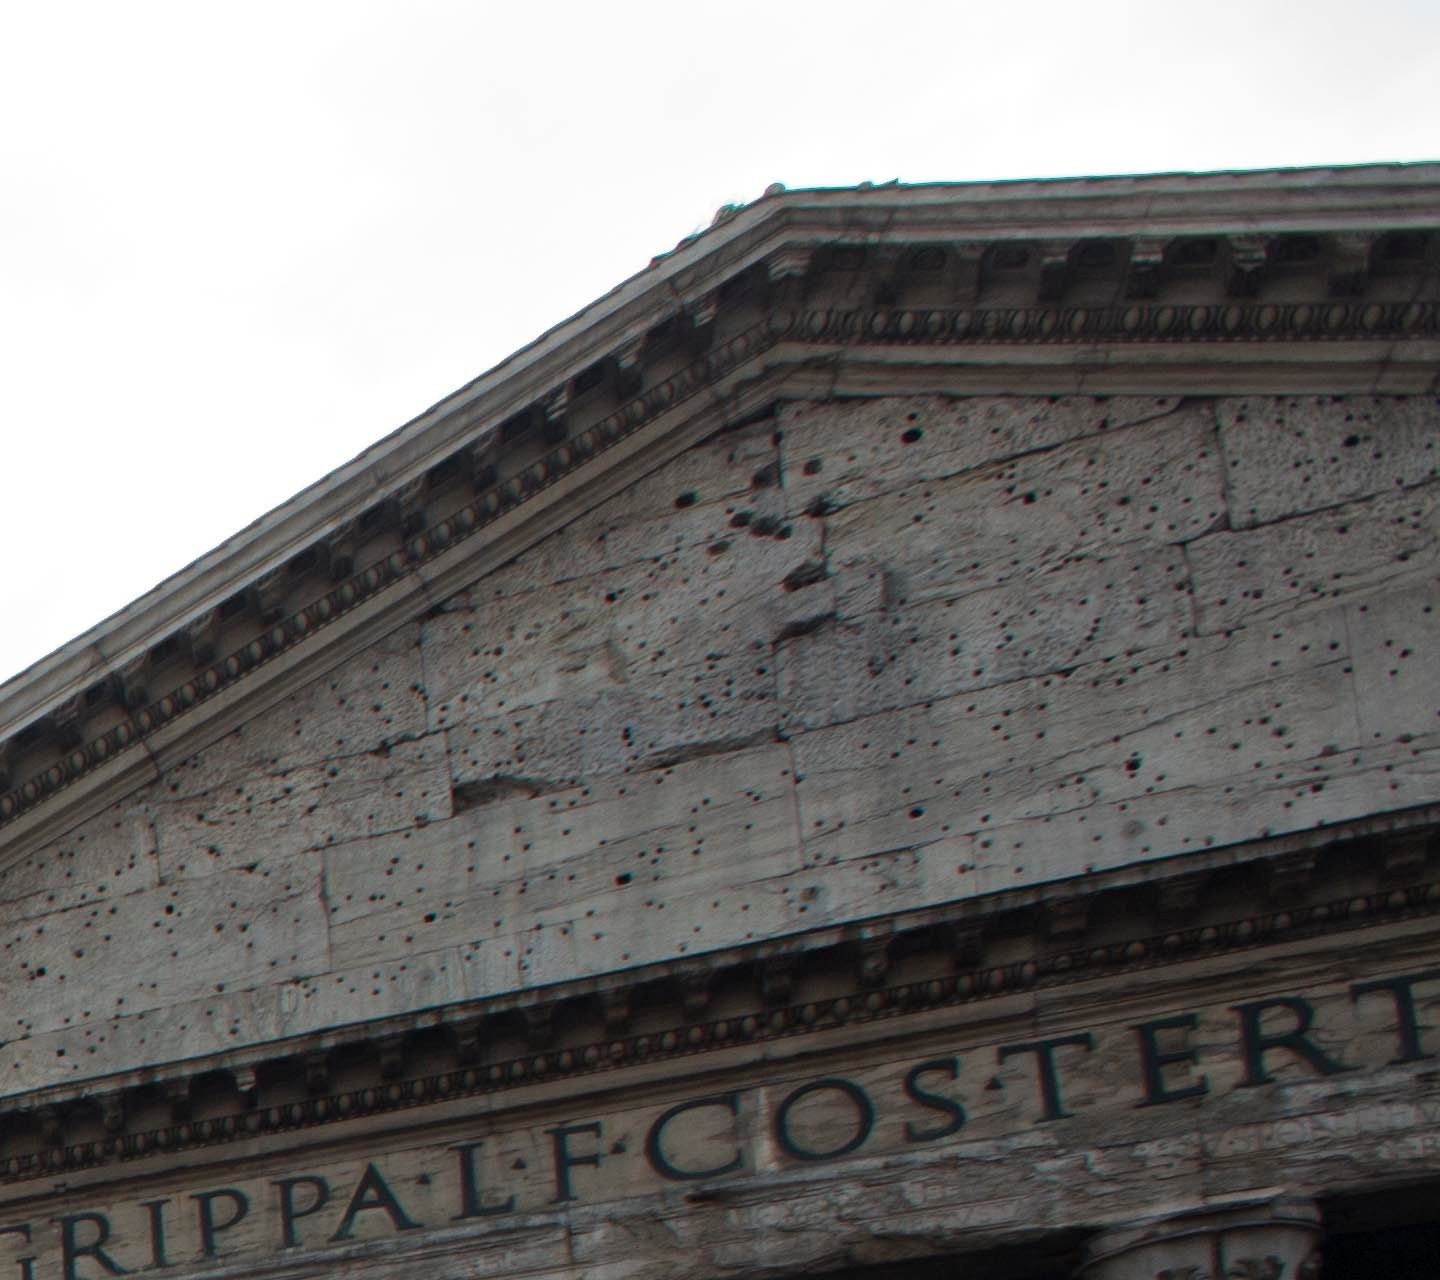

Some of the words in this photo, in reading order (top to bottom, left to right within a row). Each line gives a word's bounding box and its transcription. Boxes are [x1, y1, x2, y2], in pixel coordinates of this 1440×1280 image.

[447, 1142, 515, 1220] L
[544, 1120, 604, 1201] F
[644, 1058, 969, 1180] COS
